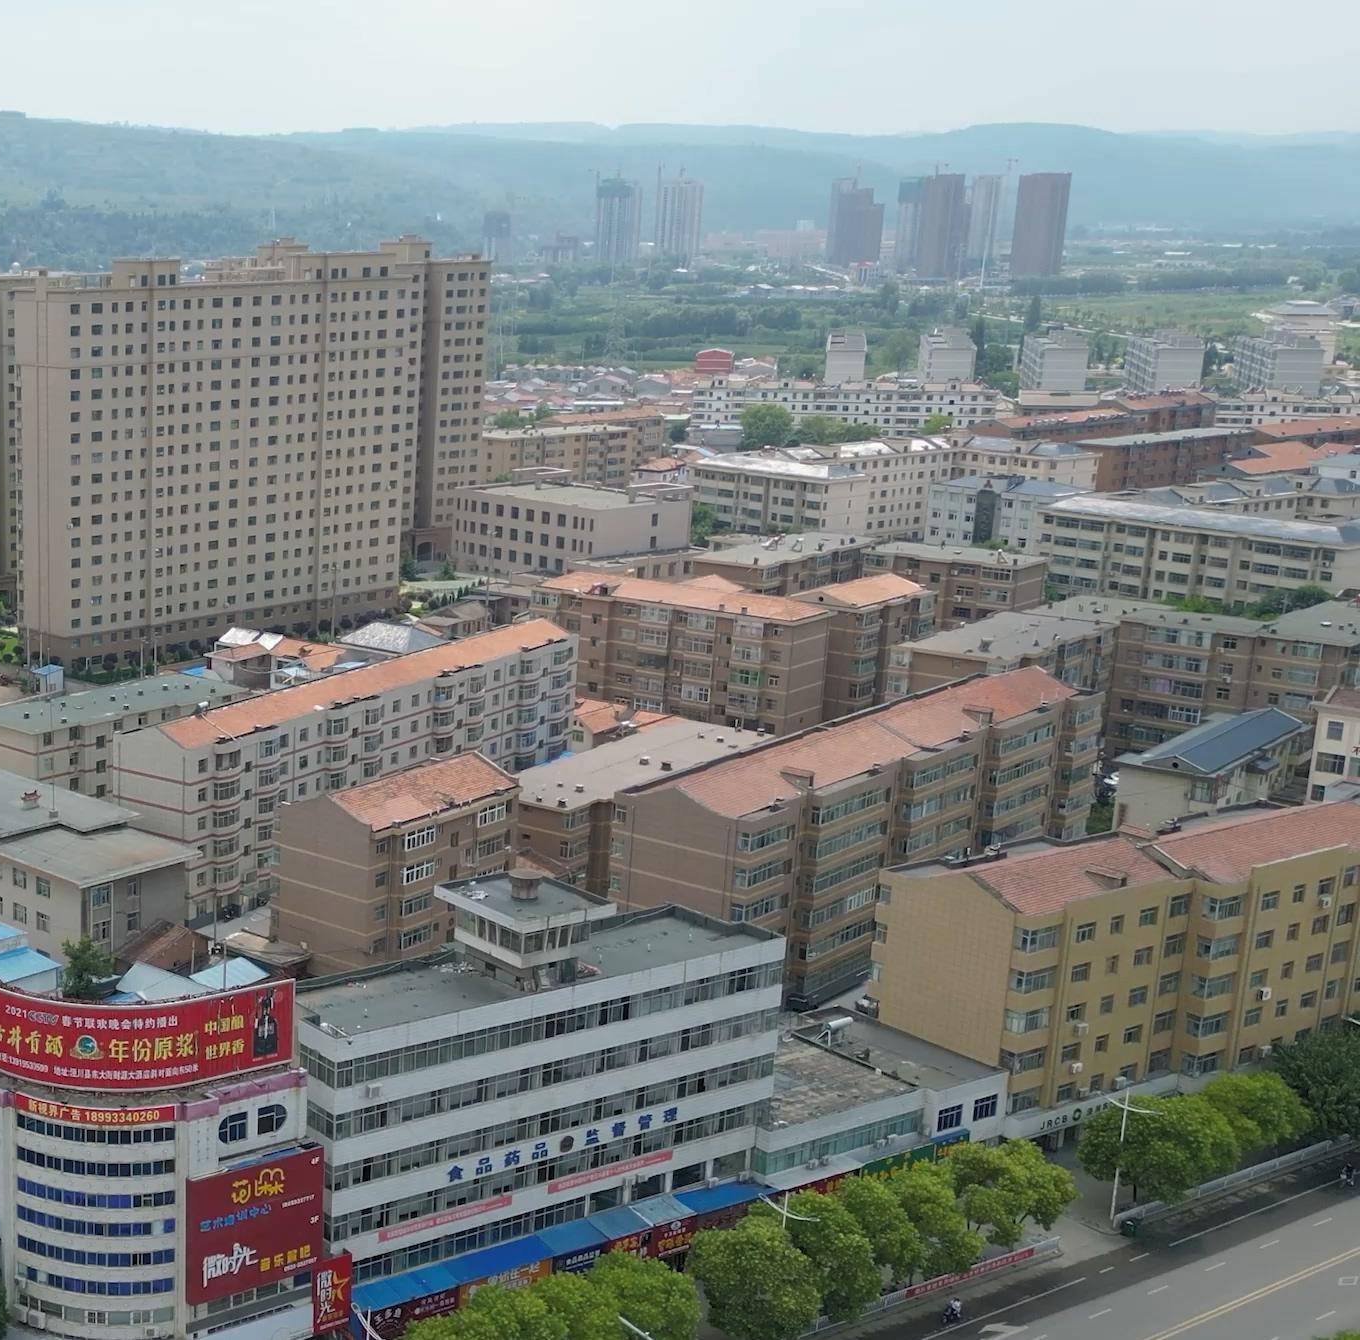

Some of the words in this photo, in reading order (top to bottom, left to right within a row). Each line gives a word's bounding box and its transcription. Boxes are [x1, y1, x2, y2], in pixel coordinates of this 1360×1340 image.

[5, 1005, 28, 1018] 2021
[108, 1033, 195, 1063] 年份原浆
[28, 1099, 81, 1121] 新视界广告
[85, 1110, 160, 1123] 18993340260
[447, 1142, 548, 1182] 食品药品
[585, 1107, 678, 1146] 监督管理
[309, 1216, 320, 1225] 3F
